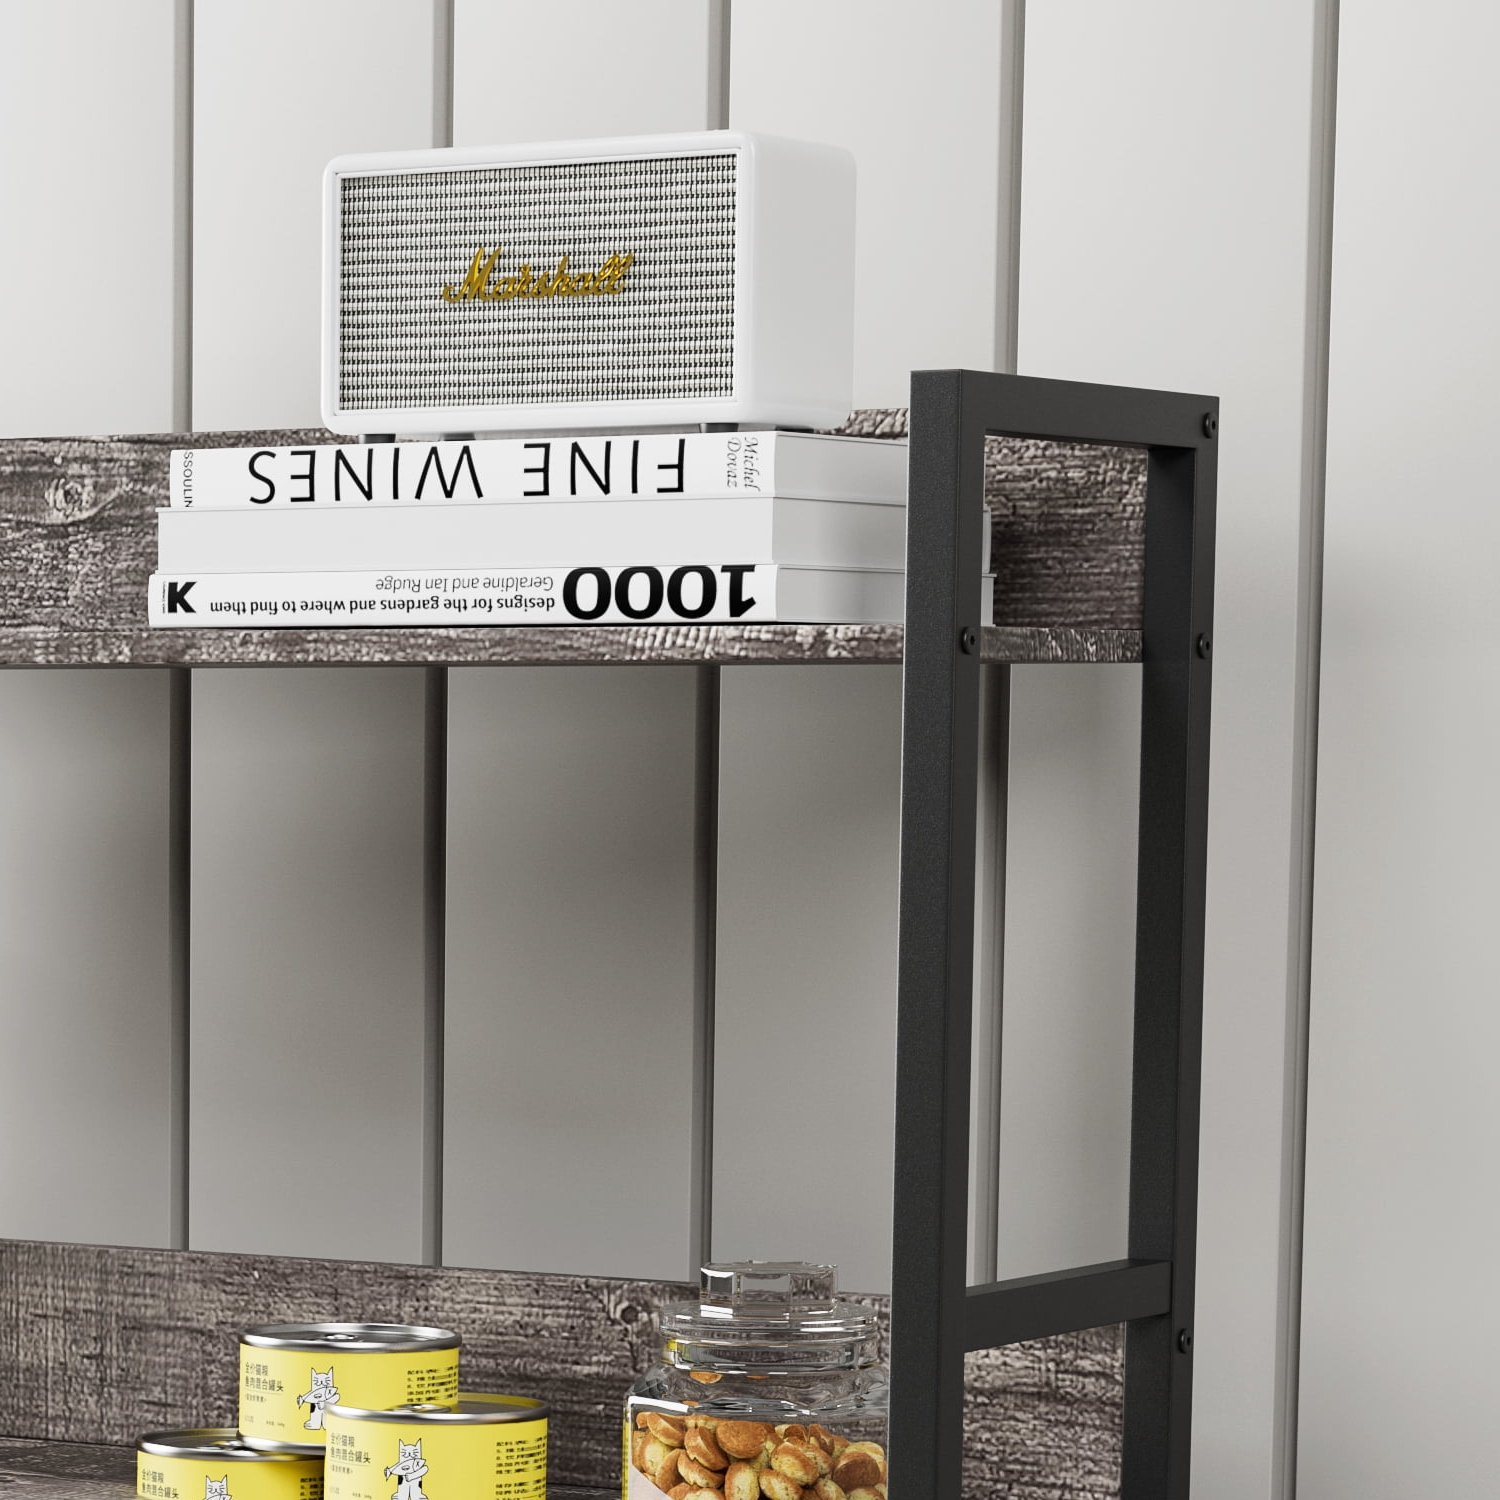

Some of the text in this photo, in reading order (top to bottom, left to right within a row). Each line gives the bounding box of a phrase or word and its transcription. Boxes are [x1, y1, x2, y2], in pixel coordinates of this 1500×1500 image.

[442, 248, 633, 302] Marshall
[248, 438, 686, 504] FINE WINES
[727, 437, 742, 488] Dovaz
[745, 436, 761, 492] Michel
[167, 581, 197, 614] K
[210, 596, 555, 615] designs for the gardens and where to find them
[375, 575, 554, 593] Geraldine and Ian Rudge
[563, 564, 756, 620] 1000
